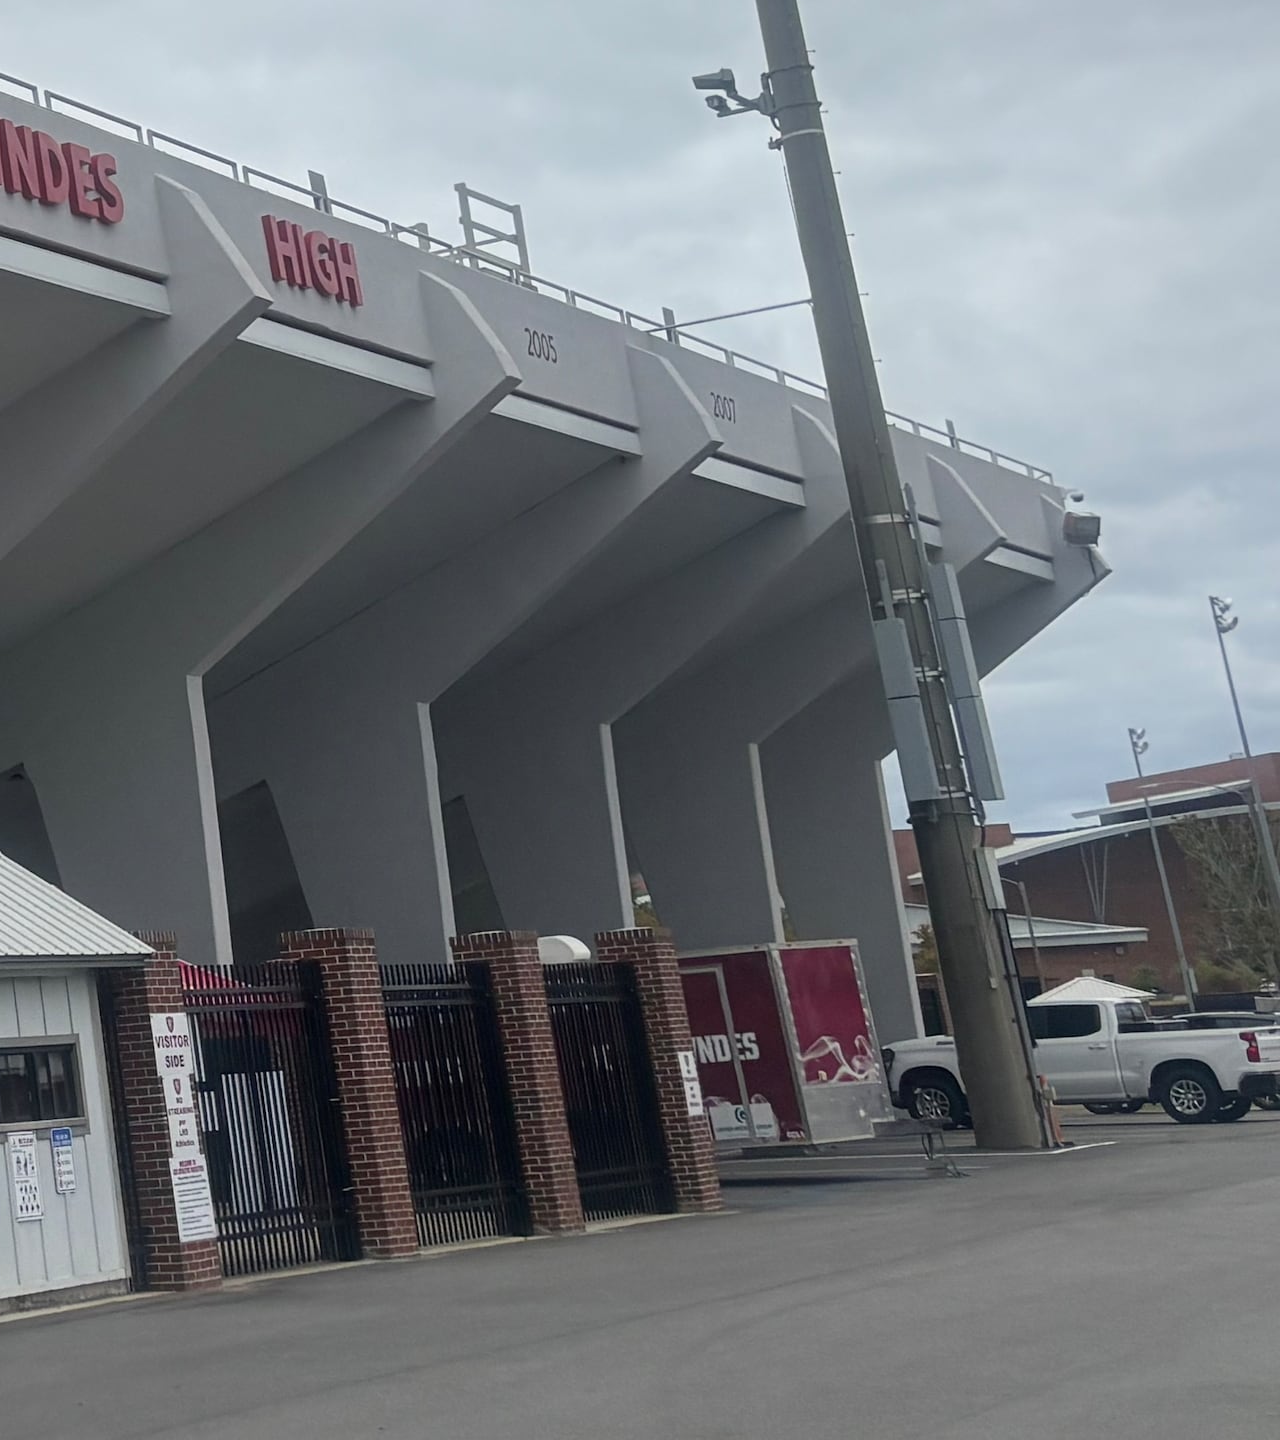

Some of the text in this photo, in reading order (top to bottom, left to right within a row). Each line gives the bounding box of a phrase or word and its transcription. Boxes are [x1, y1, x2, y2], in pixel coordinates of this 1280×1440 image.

[261, 214, 364, 308] HIGH
[524, 327, 558, 364] 2005
[710, 391, 737, 424] 2007
[155, 1034, 190, 1049] VISITOR
[692, 1032, 760, 1063] NDES
[165, 1054, 185, 1068] SIDE
